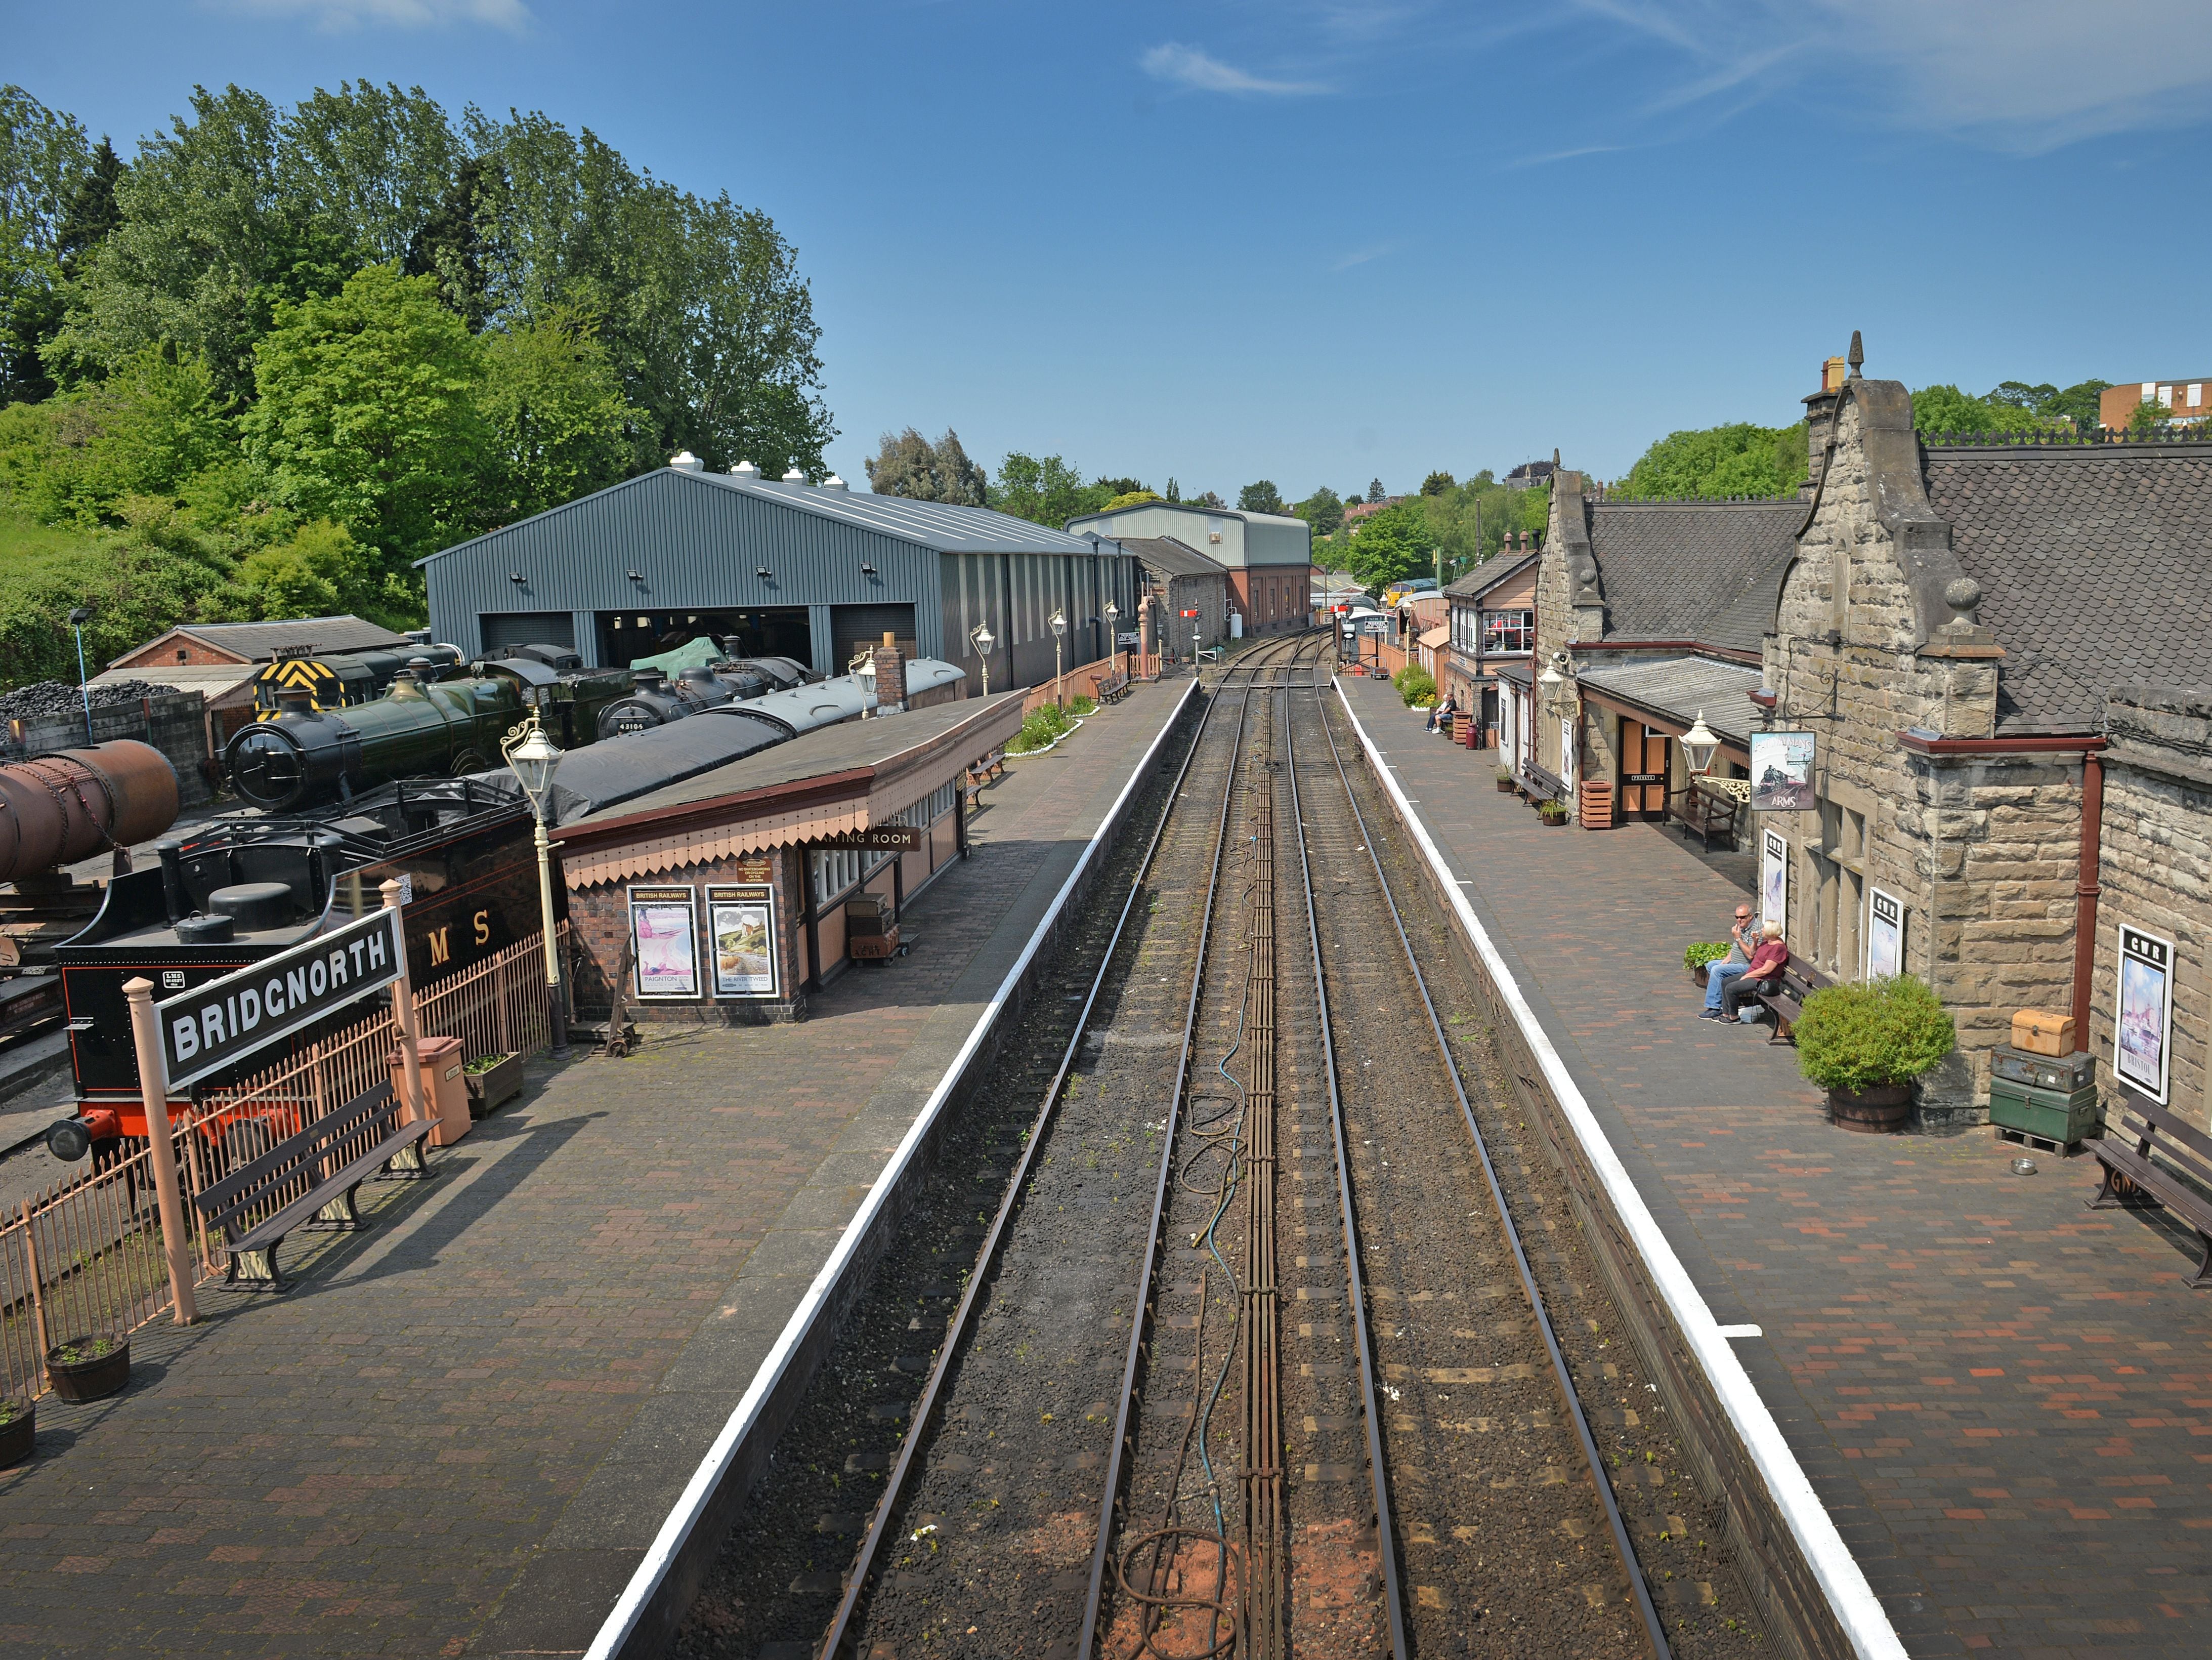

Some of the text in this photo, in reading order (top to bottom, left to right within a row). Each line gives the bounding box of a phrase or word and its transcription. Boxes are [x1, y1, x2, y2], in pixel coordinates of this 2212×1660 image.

[1771, 796, 1796, 808] ARMS
[873, 834, 911, 844] ROOM
[1877, 898, 1895, 918] GWR
[429, 909, 489, 967] M S
[2131, 937, 2159, 960] GWR
[173, 930, 386, 1062] BRIDGNORTH
[2128, 1053, 2151, 1075] BRISTOL
